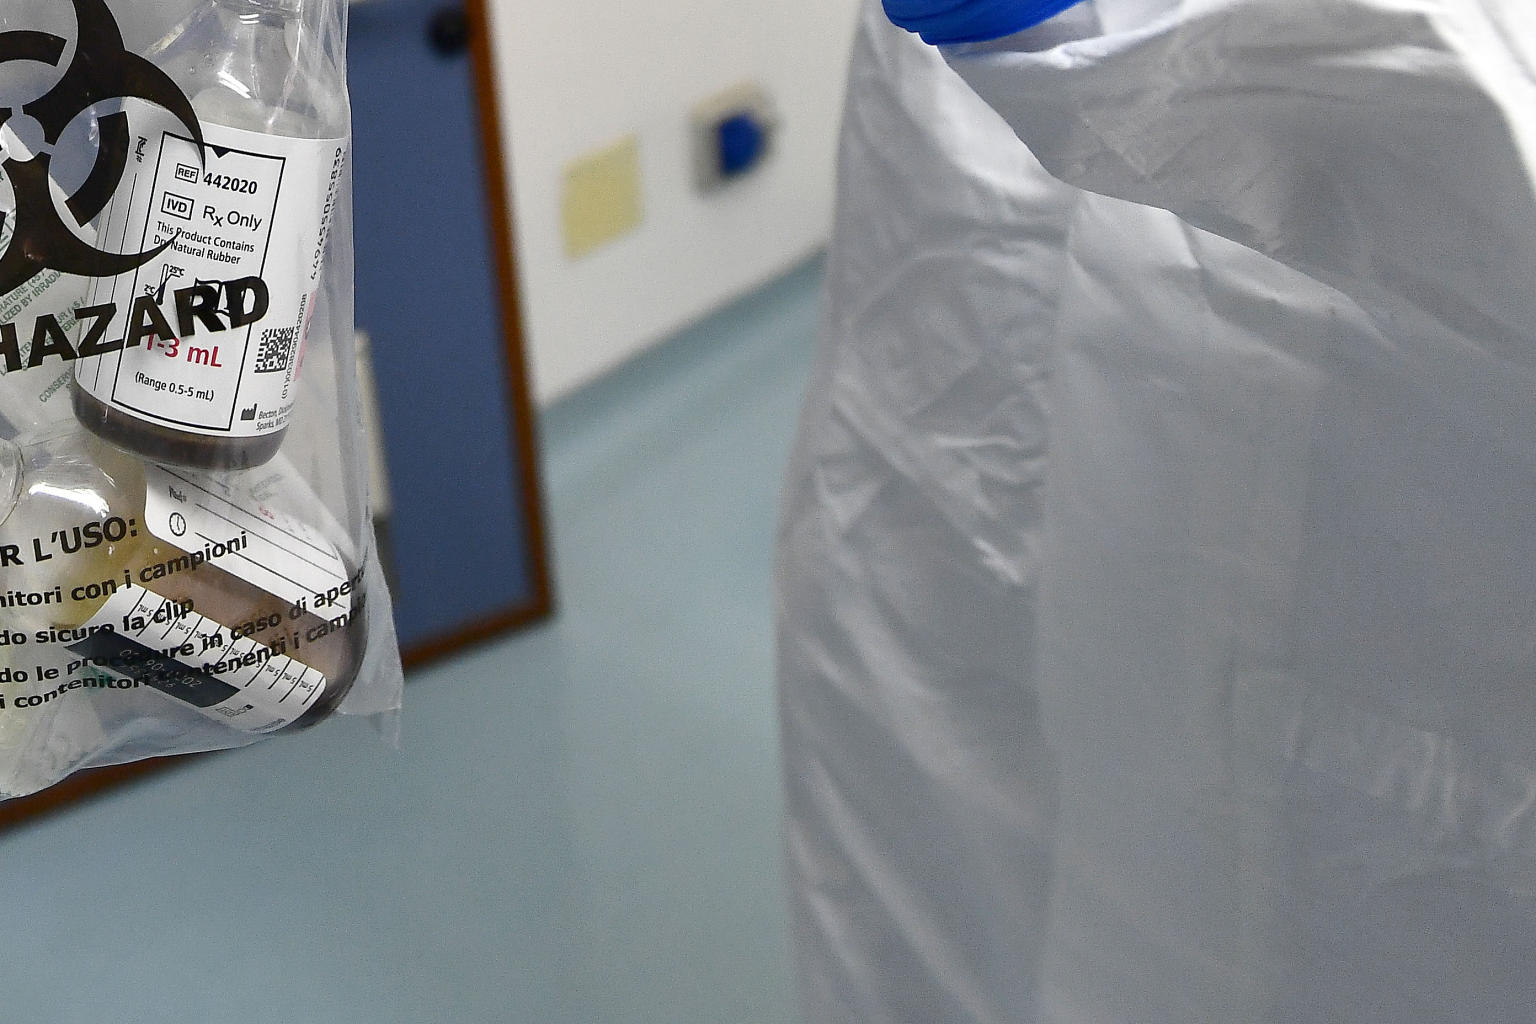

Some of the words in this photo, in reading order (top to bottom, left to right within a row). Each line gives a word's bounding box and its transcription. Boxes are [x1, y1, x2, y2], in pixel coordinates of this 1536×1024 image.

[177, 168, 196, 179] REF
[204, 173, 258, 194] 442020
[166, 198, 188, 213] IVD
[227, 211, 262, 231] Only
[157, 221, 174, 235] This
[176, 227, 212, 245] Product
[214, 237, 255, 253] Contains
[170, 240, 204, 257] Natural
[207, 249, 241, 264] Rubber
[22, 296, 33, 308] BY
[186, 346, 222, 368] mL
[135, 371, 166, 391] (Range
[168, 382, 194, 397] 0.5-5
[195, 390, 215, 402] mL)
[32, 517, 138, 563] L'USO:
[70, 578, 117, 601] con
[124, 569, 132, 589] i
[139, 531, 248, 583] campioni
[35, 623, 115, 644] sicuro
[122, 614, 145, 632] la
[153, 597, 195, 624] clip
[37, 666, 59, 682] le
[201, 633, 224, 653] in
[230, 611, 282, 640] caso
[289, 596, 307, 620] di
[14, 674, 150, 708] contenitori
[293, 631, 300, 650] i
